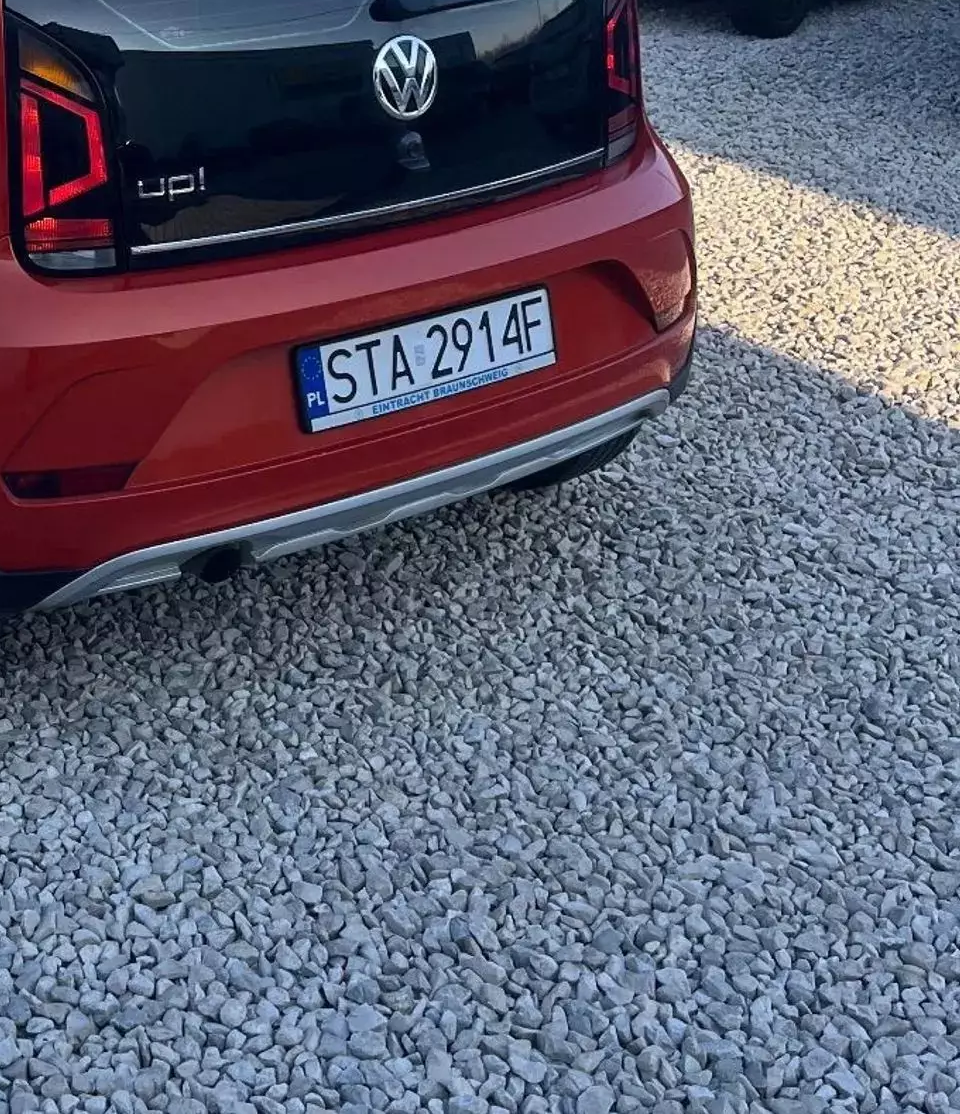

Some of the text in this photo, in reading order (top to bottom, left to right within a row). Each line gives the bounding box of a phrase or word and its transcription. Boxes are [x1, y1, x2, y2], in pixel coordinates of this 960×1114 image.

[137, 166, 206, 201] up!
[327, 296, 542, 404] STA 2914F
[307, 392, 325, 408] PL
[372, 368, 509, 415] EINTRACHT BRAUNSCHWEIG
